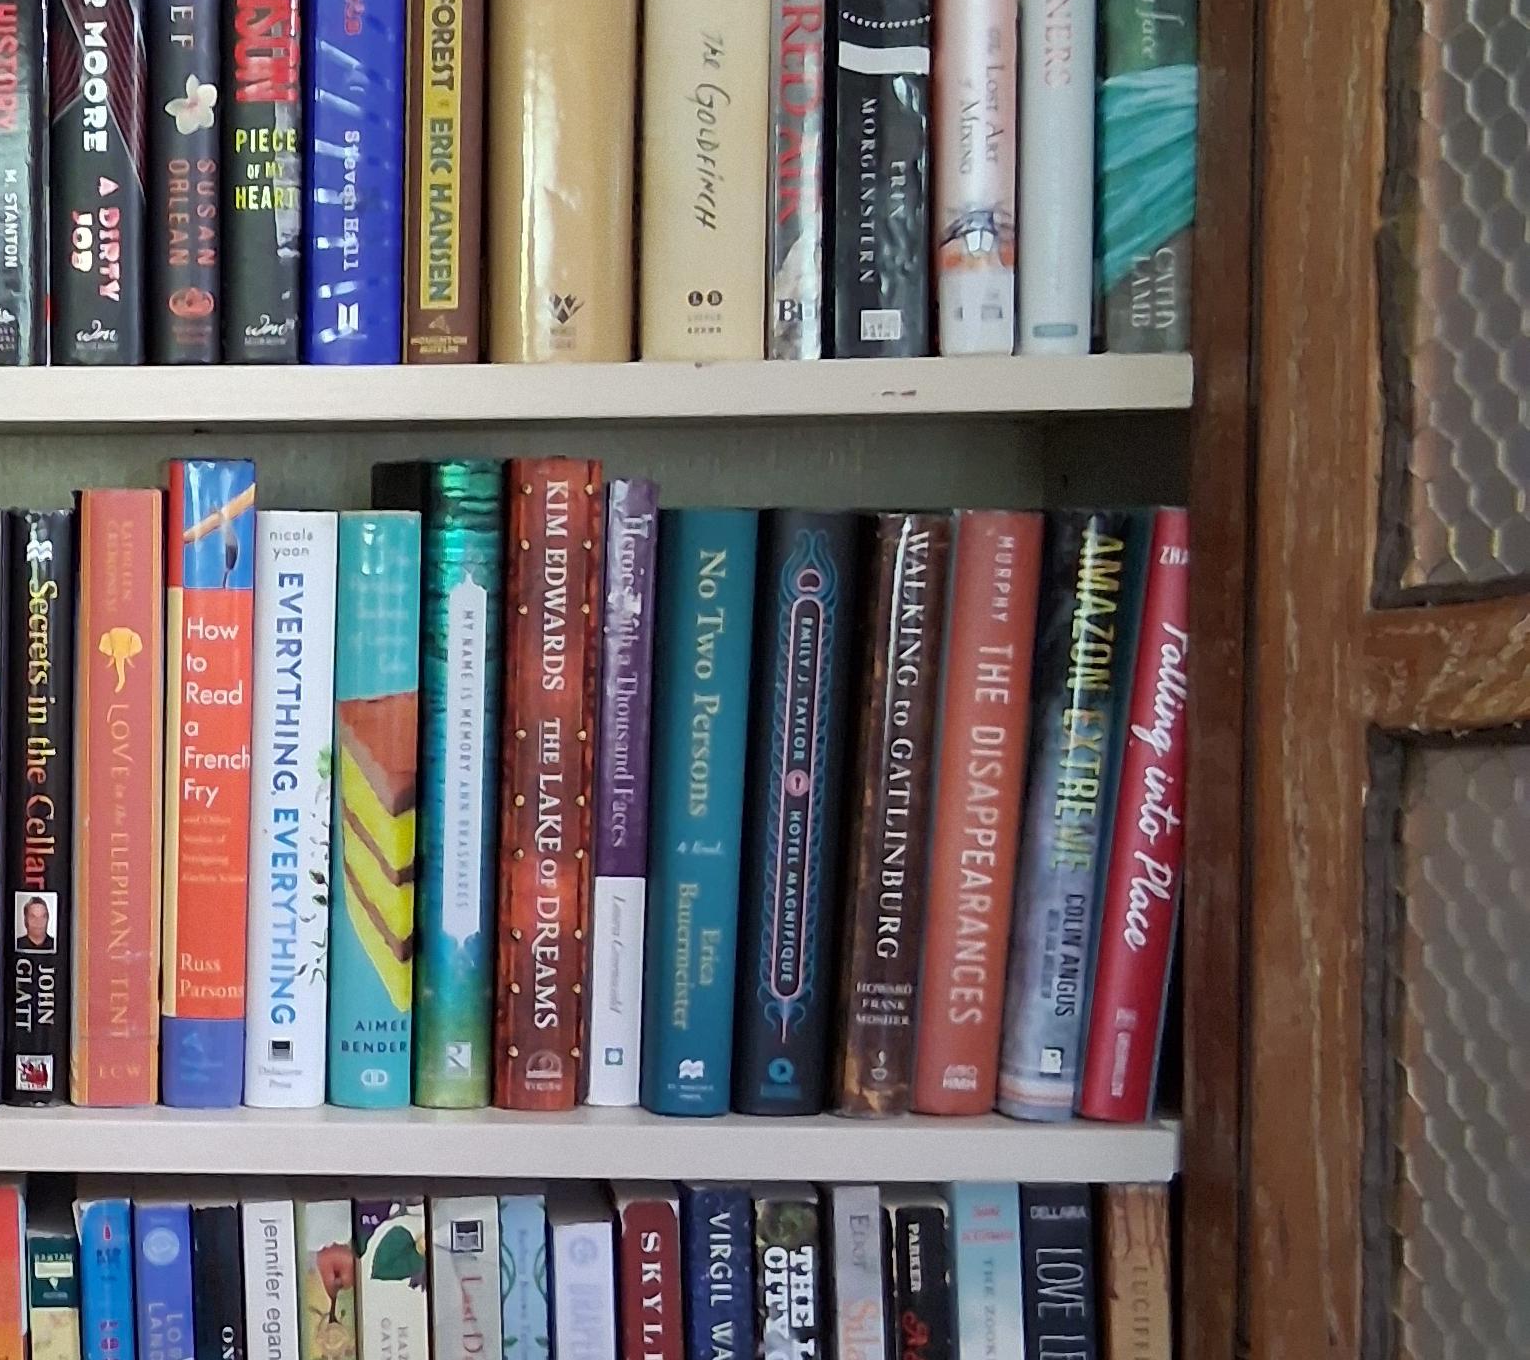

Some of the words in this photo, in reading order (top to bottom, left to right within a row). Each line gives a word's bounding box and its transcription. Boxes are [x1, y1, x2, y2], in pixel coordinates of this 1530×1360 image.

[83, 20, 108, 153] MOORE
[431, 118, 454, 177] ERIC
[429, 188, 453, 304] HANSEN
[28, 580, 58, 685] Secrets
[186, 619, 239, 640] How
[896, 530, 930, 689] WALKING
[186, 682, 243, 705] Read
[977, 644, 1014, 704] THE
[29, 697, 56, 726] in
[893, 698, 910, 726] to
[28, 736, 56, 782] the
[184, 746, 251, 769] French
[184, 779, 218, 808] Fry
[27, 790, 54, 890] Cellar
[876, 738, 913, 961] GATLINBURG
[948, 726, 1003, 1026] DISAPPEARANCES
[270, 806, 300, 1025] EVERYTHING
[16, 959, 32, 1032] GLATT
[38, 963, 54, 1026] JOHN
[341, 1040, 408, 1052] BENDER
[355, 1020, 408, 1033] AIMEE
[259, 1218, 282, 1304] jennifer
[709, 1212, 733, 1307] VIRGIL
